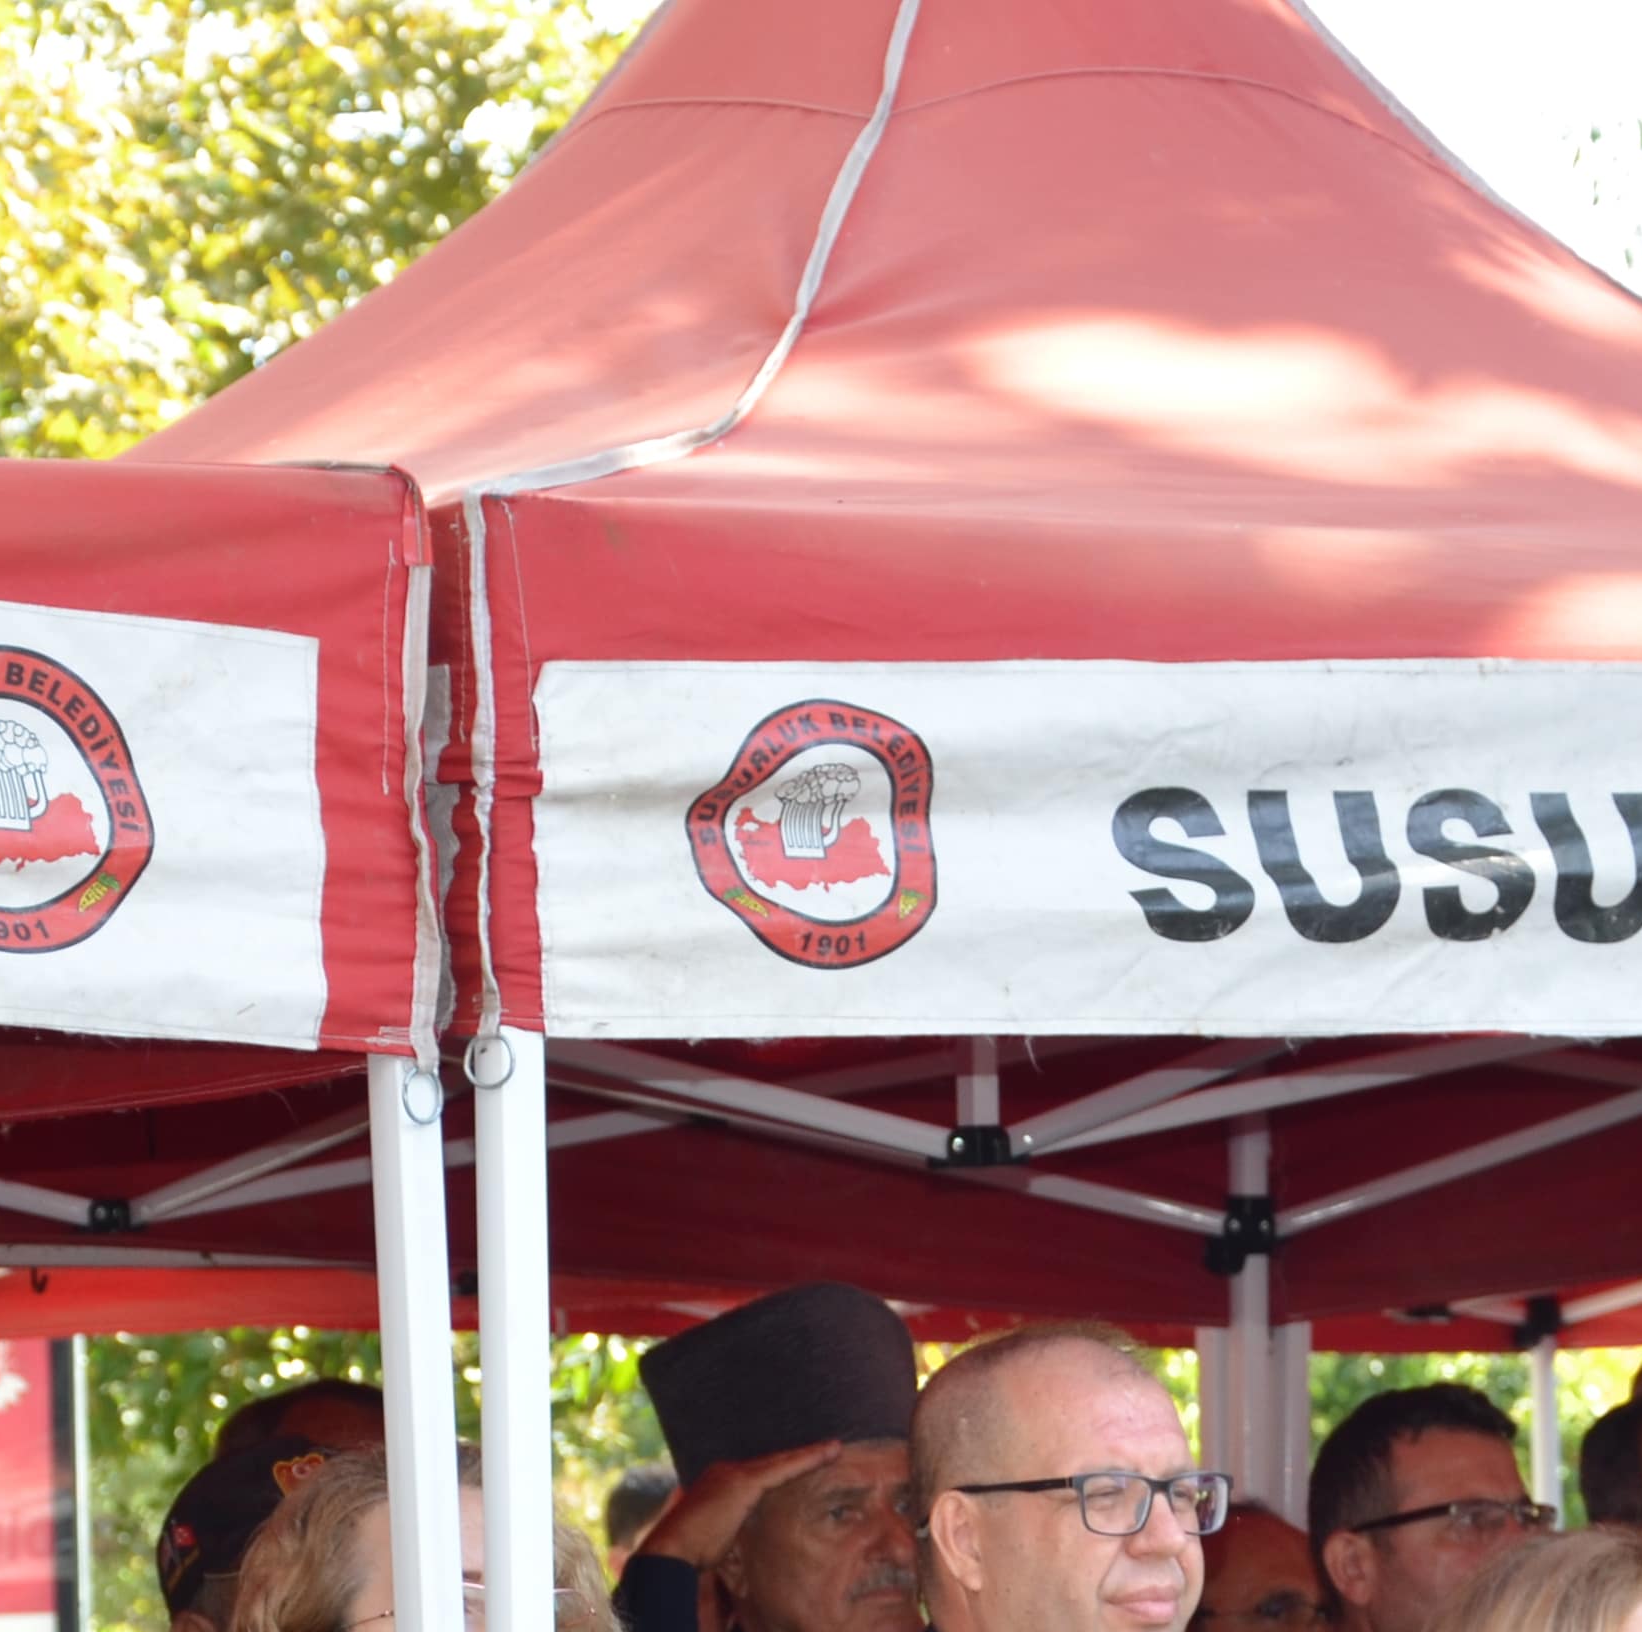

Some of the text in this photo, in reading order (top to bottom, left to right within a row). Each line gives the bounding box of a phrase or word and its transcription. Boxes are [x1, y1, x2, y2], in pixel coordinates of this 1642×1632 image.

[5, 661, 144, 833] BELEDİYESİ
[697, 712, 822, 847] SUSURLUK
[799, 931, 867, 957] 1901
